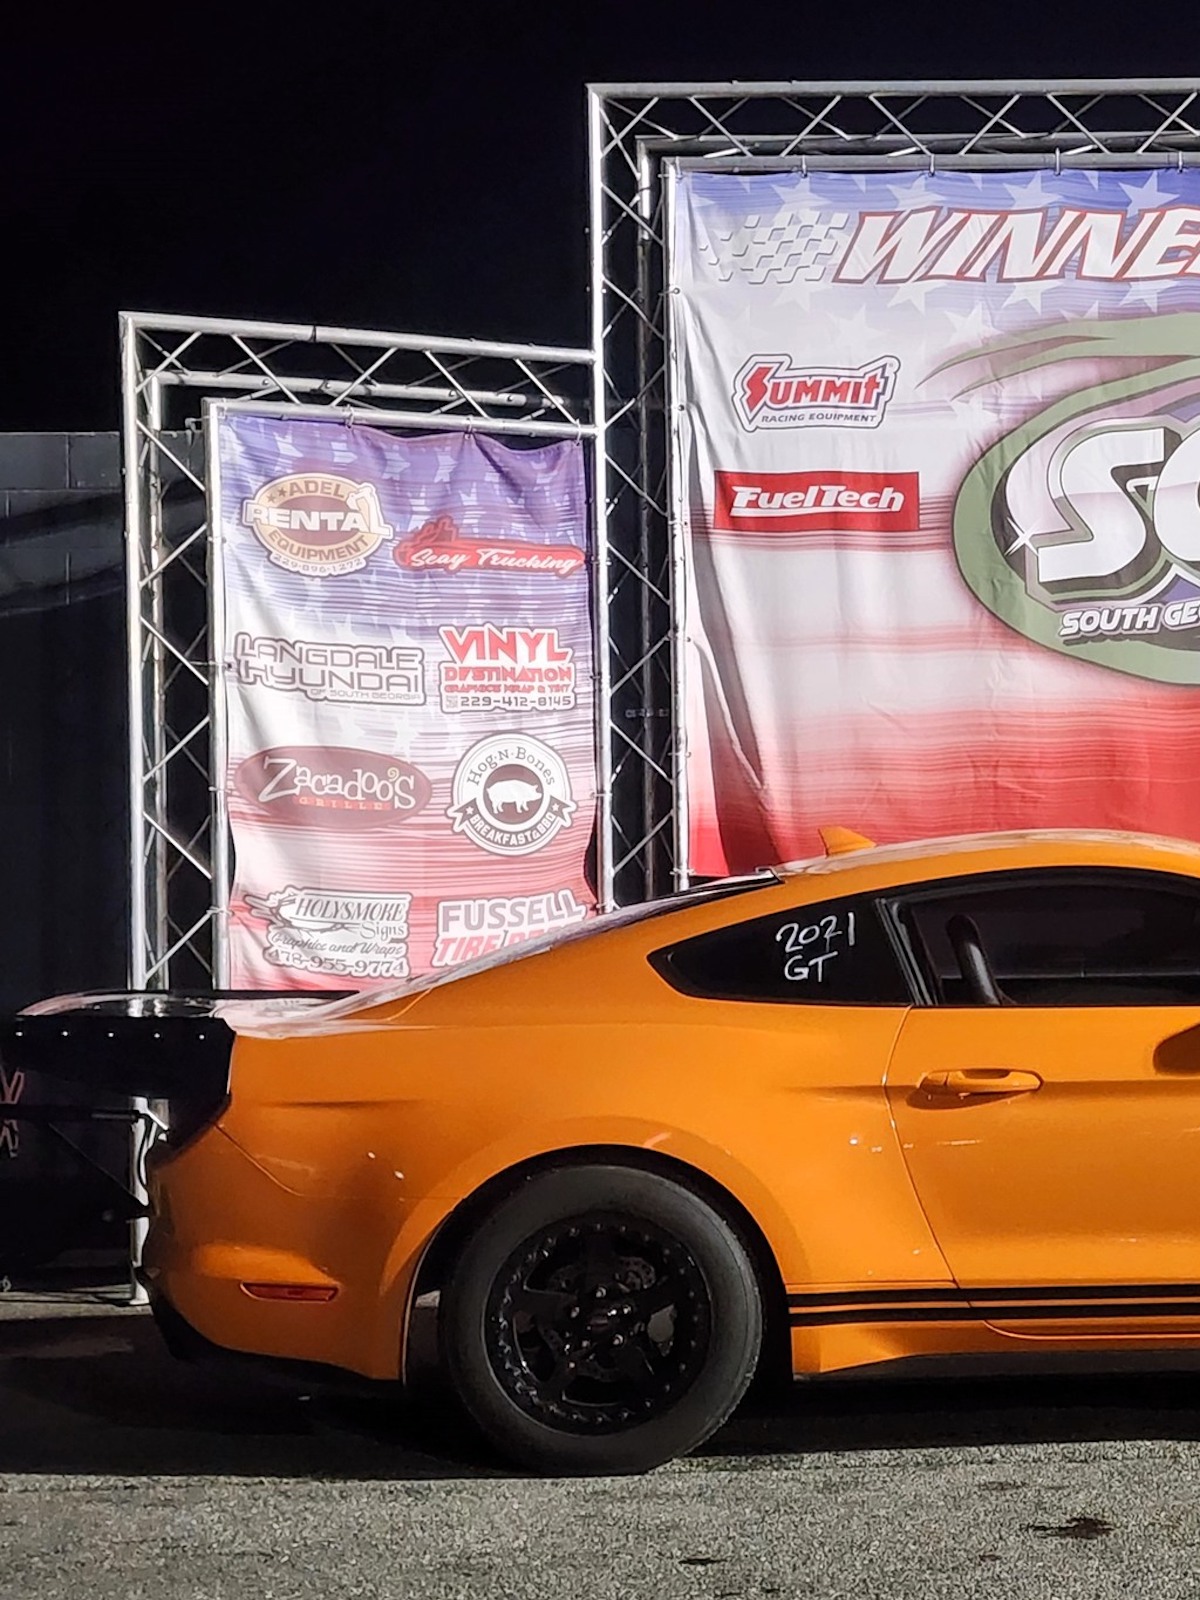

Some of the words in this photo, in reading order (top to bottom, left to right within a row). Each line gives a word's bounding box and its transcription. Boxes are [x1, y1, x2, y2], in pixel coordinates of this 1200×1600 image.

[744, 363, 886, 420] SUMMIT
[761, 413, 805, 423] RACING
[808, 412, 877, 422] EQUIPMENT
[289, 480, 345, 498] ADEL
[731, 485, 905, 514] FuelTech
[246, 503, 391, 536] RENTAL
[268, 530, 368, 561] EQUIPMENT
[410, 548, 471, 570] Seay
[476, 549, 579, 574] Trucking
[1060, 607, 1157, 636] SOUTH
[241, 638, 418, 671] LANGDALE
[442, 628, 569, 664] VINYL
[243, 660, 419, 693] HYUNDAI
[330, 689, 369, 699] SOUTH
[295, 898, 406, 921] HOLYSMOKE
[442, 893, 583, 932] FUSSELL
[360, 921, 404, 941] Signs
[776, 912, 855, 953] 2021
[437, 935, 499, 962] TIRE
[784, 951, 838, 982] GT
